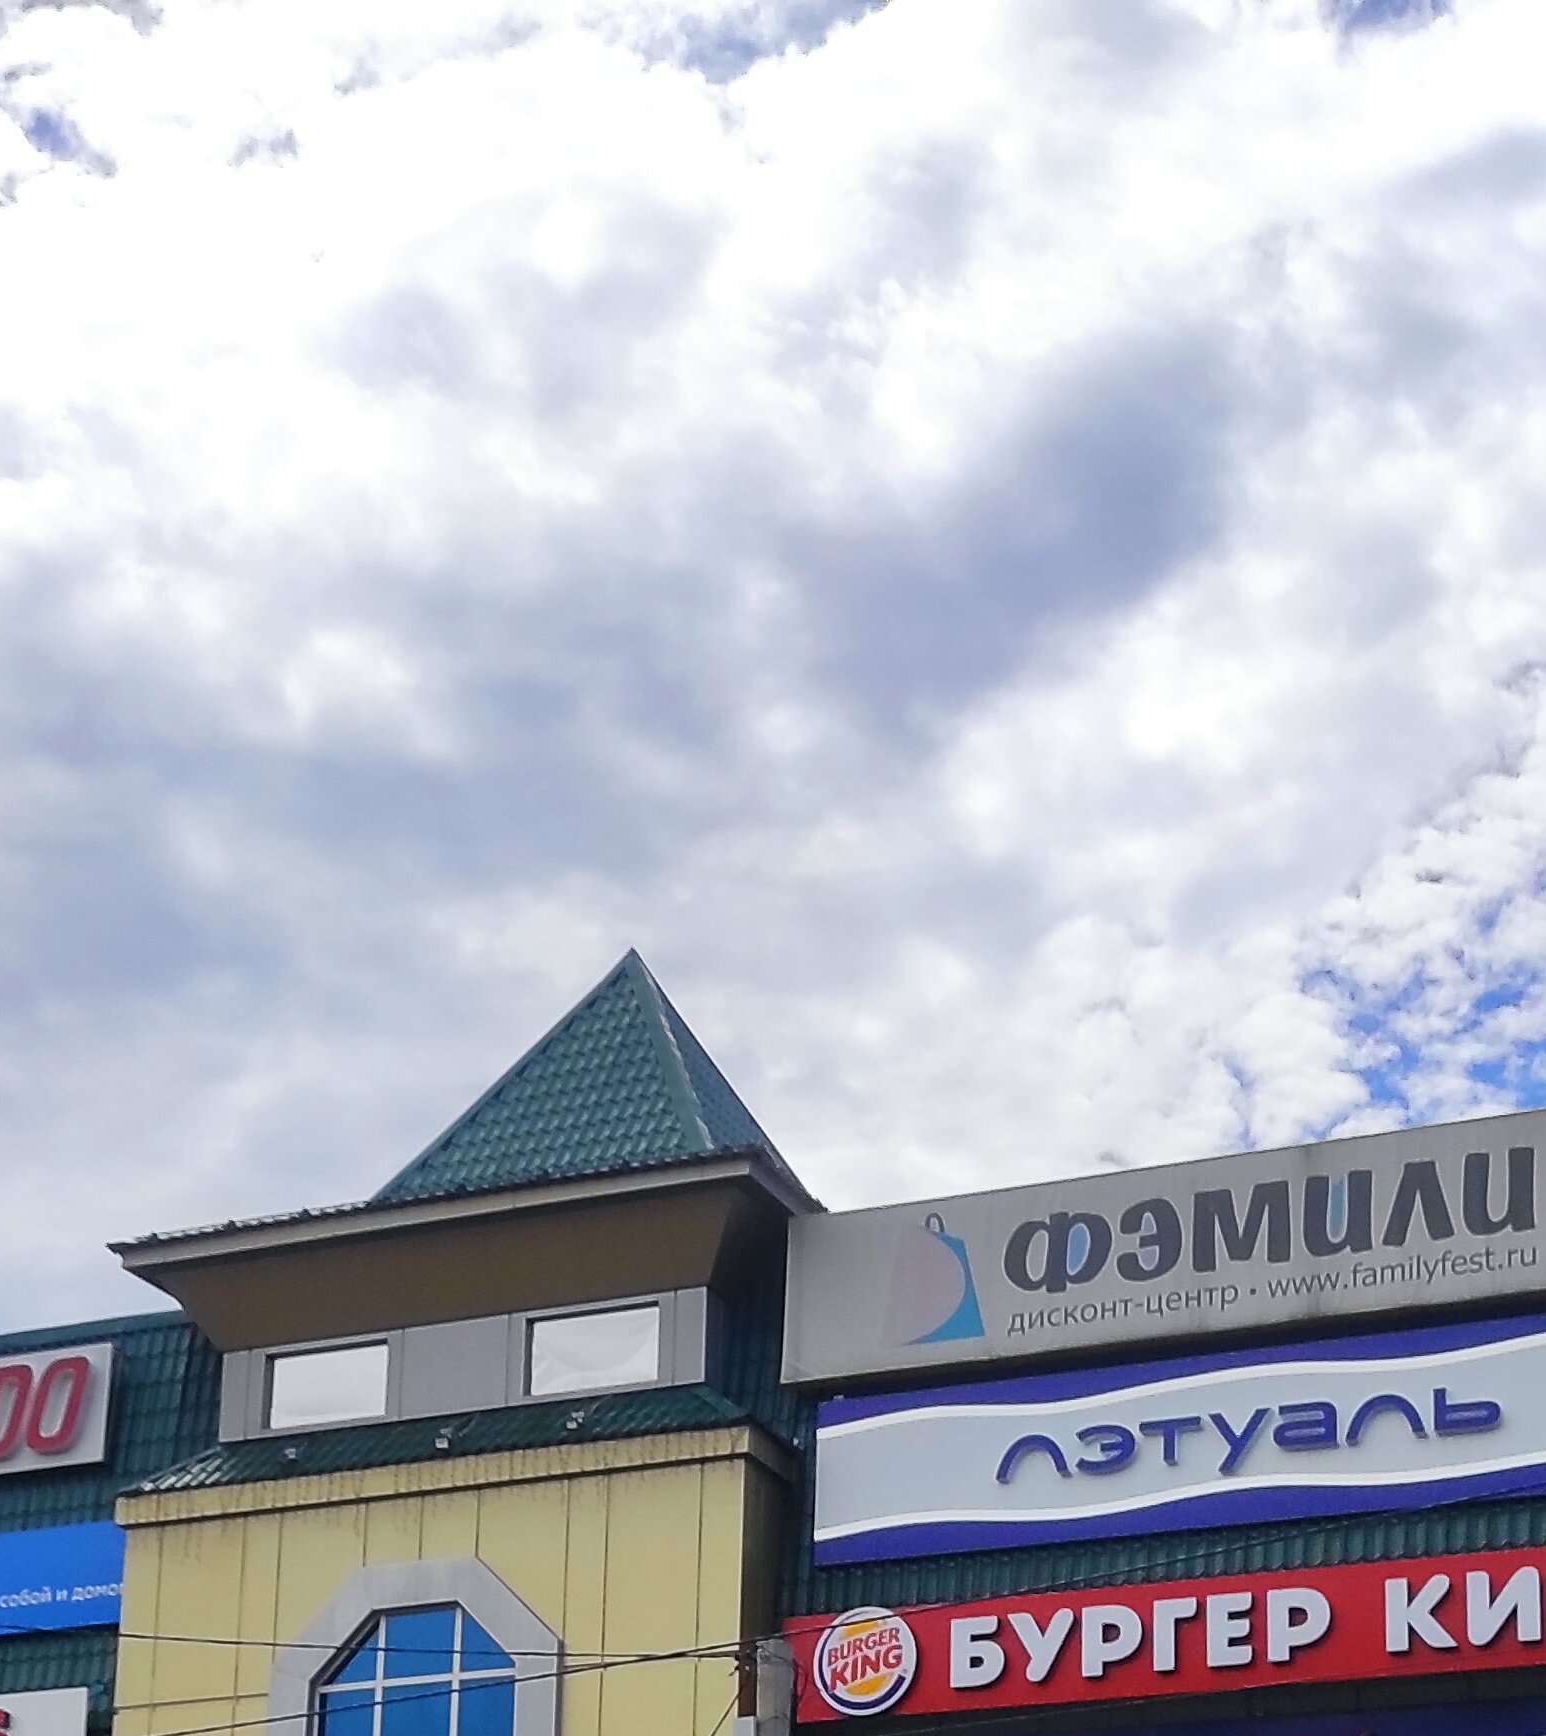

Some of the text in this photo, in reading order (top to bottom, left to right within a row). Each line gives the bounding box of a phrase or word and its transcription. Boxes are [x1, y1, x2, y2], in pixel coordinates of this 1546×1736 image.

[1007, 1243, 1538, 1337] дисконт-центр www.familyfest.ru
[0, 1587, 52, 1608] собой
[71, 1583, 123, 1601] домо
[828, 1628, 900, 1667] BURGER
[949, 1585, 1331, 1689] БУРГЕР
[830, 1645, 902, 1693] KING
